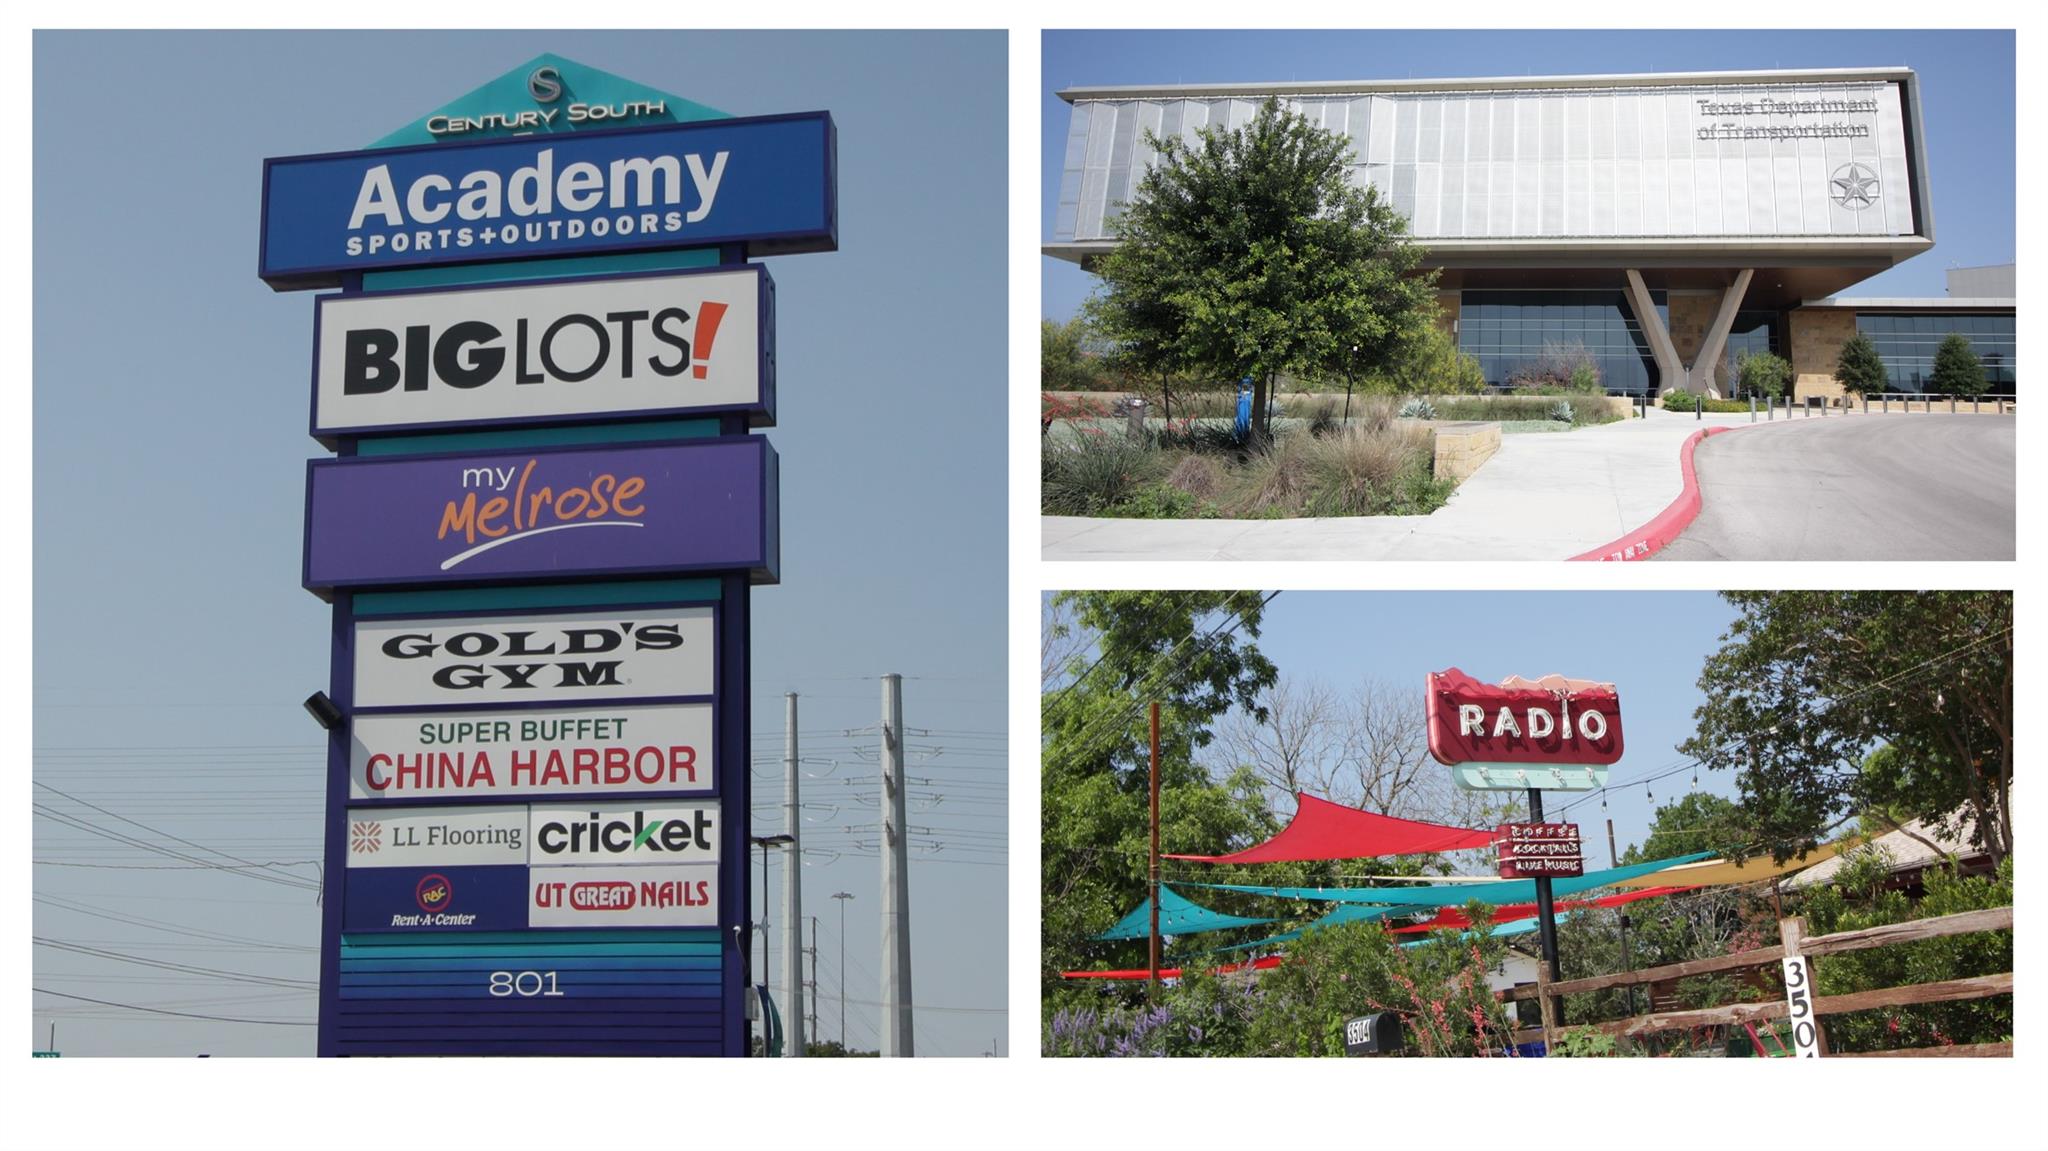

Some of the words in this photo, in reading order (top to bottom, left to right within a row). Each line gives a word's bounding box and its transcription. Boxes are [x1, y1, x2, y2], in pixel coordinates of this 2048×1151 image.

[426, 108, 559, 133] CENTURY
[567, 100, 664, 121] SOUTH
[1697, 99, 1754, 115] Texas
[1760, 97, 1878, 118] Department
[1697, 123, 1716, 140] of
[1720, 122, 1869, 142] Transportation
[346, 148, 730, 230] Academy
[345, 212, 683, 257] SPORTS+OUTDOORS
[463, 466, 515, 491] my
[438, 459, 645, 544] Melrose
[382, 622, 684, 659] GOLD'S
[433, 661, 625, 689] GYM
[420, 721, 511, 744] SUPER
[520, 718, 628, 741] BUFFET
[1459, 699, 1608, 741] RADIO
[366, 751, 496, 790] CHINA
[511, 746, 697, 786] HARBOR
[393, 827, 421, 847] LL
[427, 824, 522, 849] Flooring
[538, 810, 712, 854] cricket
[1511, 826, 1577, 837] COFFEE
[1512, 842, 1578, 855] COCKTAILS
[1516, 860, 1543, 871] LIVE
[1544, 859, 1580, 871] MUSIC
[423, 886, 446, 903] RAC
[536, 883, 566, 907] UT
[574, 885, 633, 907] GREAT
[641, 881, 709, 908] NAILS
[489, 971, 564, 996] 801
[1787, 961, 1815, 1058] 350
[1348, 1021, 1371, 1044] 3504
